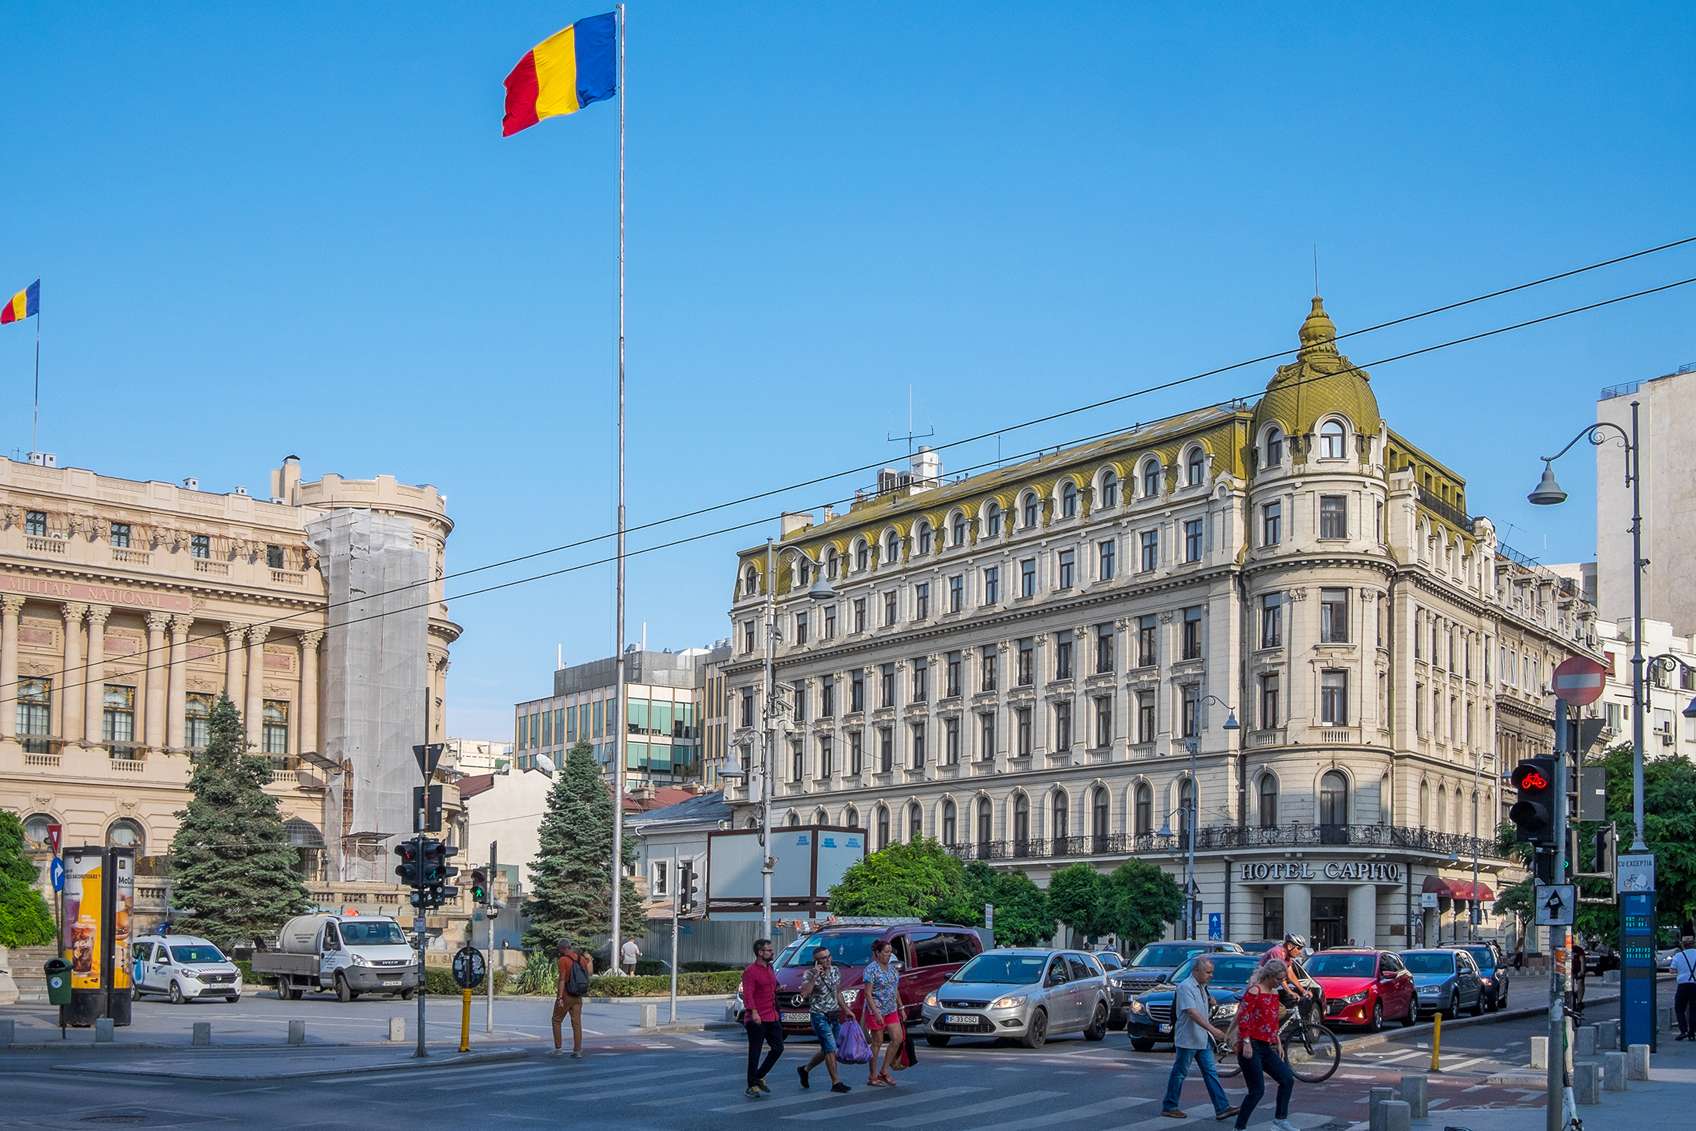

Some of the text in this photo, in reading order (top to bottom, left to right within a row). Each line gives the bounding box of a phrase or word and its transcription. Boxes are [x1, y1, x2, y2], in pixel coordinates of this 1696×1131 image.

[9, 576, 160, 607] MILITAR NATIONAL
[1241, 862, 1315, 880] HOTEL
